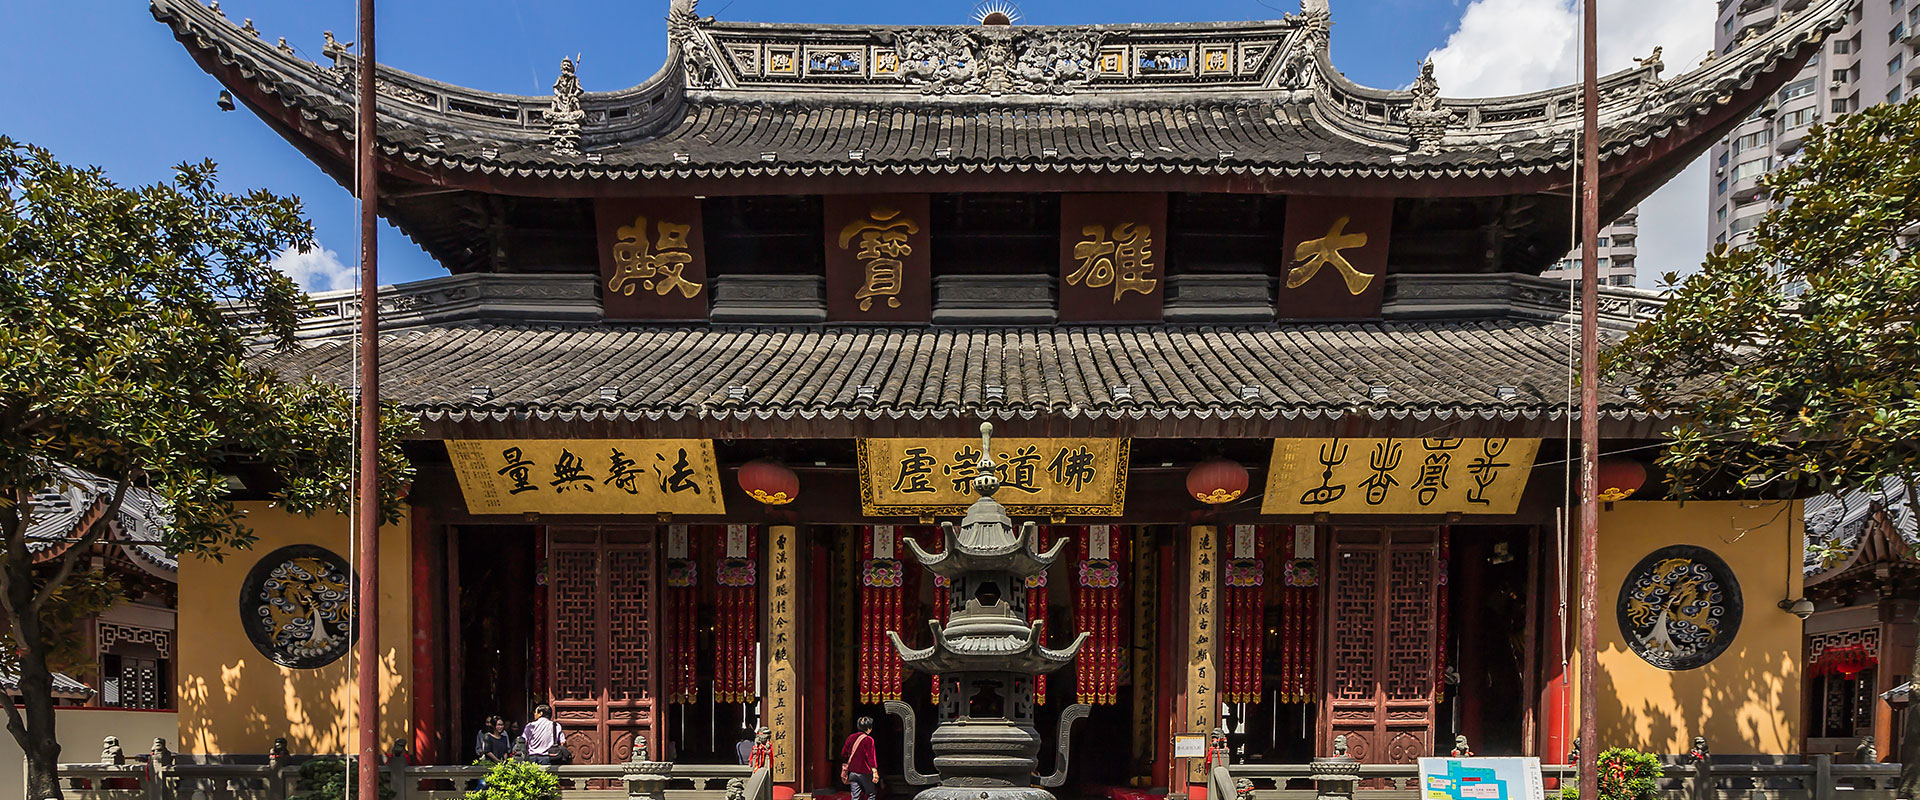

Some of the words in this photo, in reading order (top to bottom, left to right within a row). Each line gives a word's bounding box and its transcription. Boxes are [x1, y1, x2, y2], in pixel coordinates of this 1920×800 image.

[608, 215, 702, 298] 殿
[838, 208, 920, 311] 寶
[1066, 222, 1157, 304] 雄
[1286, 216, 1375, 295] 大
